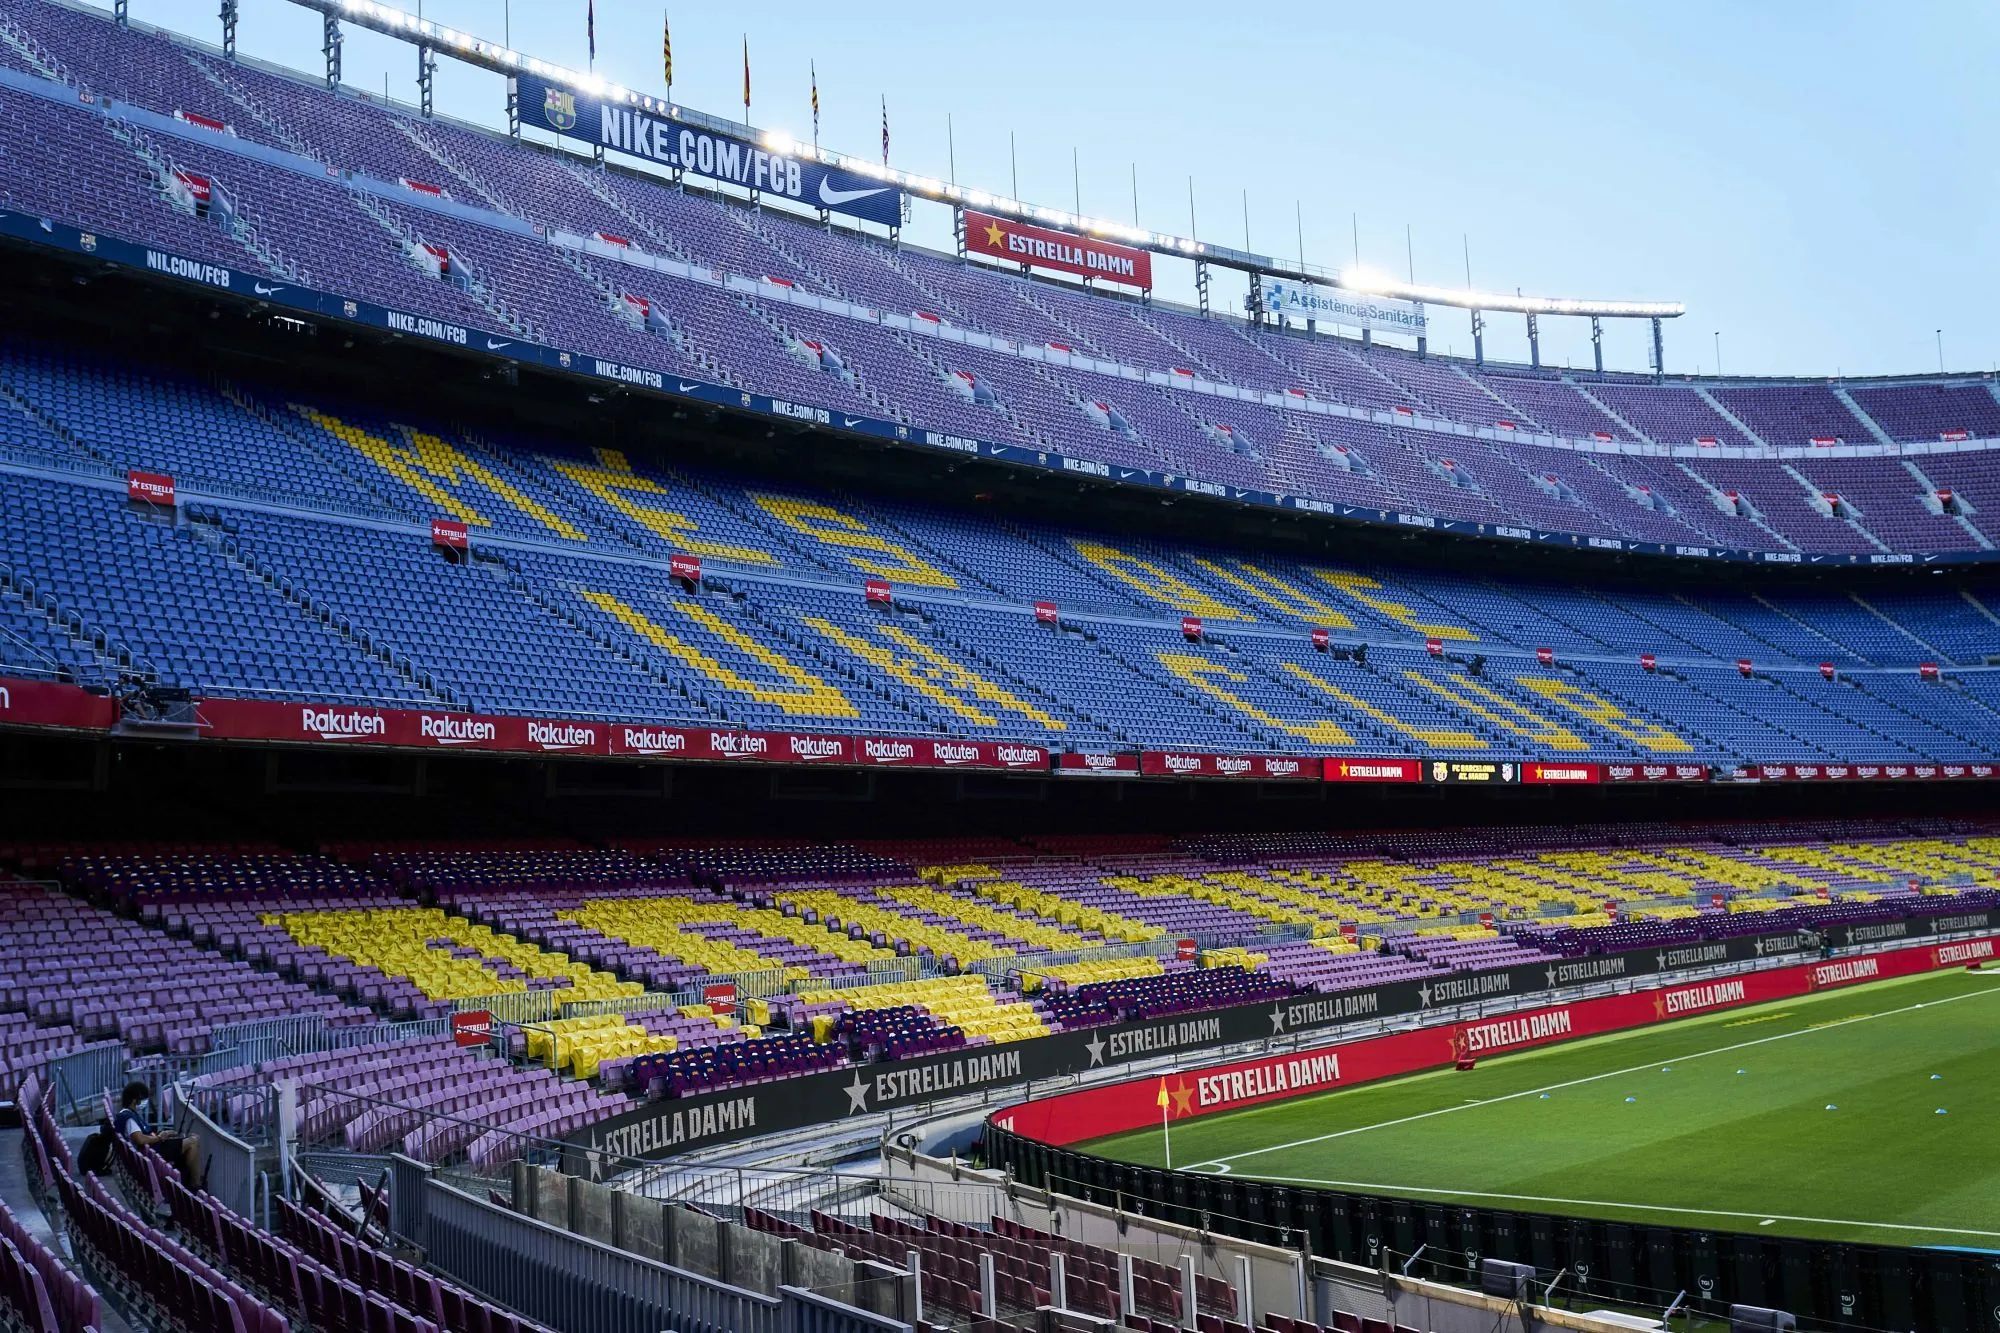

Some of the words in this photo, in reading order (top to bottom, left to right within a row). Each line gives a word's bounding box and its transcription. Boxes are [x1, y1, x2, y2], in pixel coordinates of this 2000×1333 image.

[600, 104, 802, 197] NIKE.COM/FCB
[1008, 233, 1084, 266] ESTRELLA
[1086, 250, 1134, 277] DAMM
[140, 482, 174, 495] ESTRELLA
[441, 529, 467, 539] ESTRELLA
[678, 562, 699, 571] ESTRELLA
[302, 708, 385, 734] Rakuten
[421, 715, 496, 740] Rakuten
[527, 722, 595, 745] Rakuten
[624, 728, 685, 750] Rakuten
[710, 732, 767, 752] Rakuten
[790, 736, 842, 756] Rakuten
[865, 739, 914, 757] Rakuten
[933, 743, 979, 760] Rakuten
[997, 745, 1040, 762] Rakuten
[1085, 754, 1117, 767] Rakuten
[1165, 754, 1201, 769] Rakuten
[1216, 757, 1252, 771] Rakuten
[1265, 758, 1299, 773] Rakuten
[1349, 765, 1381, 777] ESTRELLA
[1381, 766, 1403, 778] DAMM
[1543, 769, 1570, 780] ESTRELLA
[1571, 770, 1588, 780] DAMM
[1609, 766, 1634, 776] Rakuten
[1856, 928, 1886, 943] ESTRELLA
[1886, 924, 1906, 938] DAMM
[1938, 918, 1968, 932] ESTRELLA
[1968, 915, 1988, 927] DAMM
[1765, 936, 1798, 952] ESTRELLA
[1938, 946, 1972, 964] ESTRELLA
[1972, 940, 1994, 958] DAMM
[1668, 948, 1702, 966] ESTRELLA
[1702, 945, 1727, 960] DAMM
[1558, 961, 1601, 981] ESTRELLA
[1602, 958, 1626, 974] DAMM
[1816, 964, 1854, 985] ESTRELLA
[1854, 958, 1879, 977] DAMM
[1434, 978, 1483, 1002] ESTRELLA
[1484, 973, 1510, 993] DAMM
[1666, 988, 1712, 1013] ESTRELLA
[1712, 980, 1745, 1004] DAMM
[1289, 998, 1342, 1026] ESTRELLA
[1343, 992, 1378, 1014] DAMM
[1110, 1022, 1179, 1057] ESTRELLA
[1180, 1018, 1221, 1043] DAMM
[1468, 1018, 1530, 1051] ESTRELLA
[1530, 1010, 1572, 1038] DAMM
[876, 1062, 964, 1104] ESTRELLA
[966, 1051, 1021, 1083] DAMM
[1198, 1063, 1286, 1106] ESTRELLA
[1288, 1053, 1340, 1088] DAMM
[605, 1105, 686, 1166] ESTRELLA
[688, 1097, 756, 1140] DAMM
